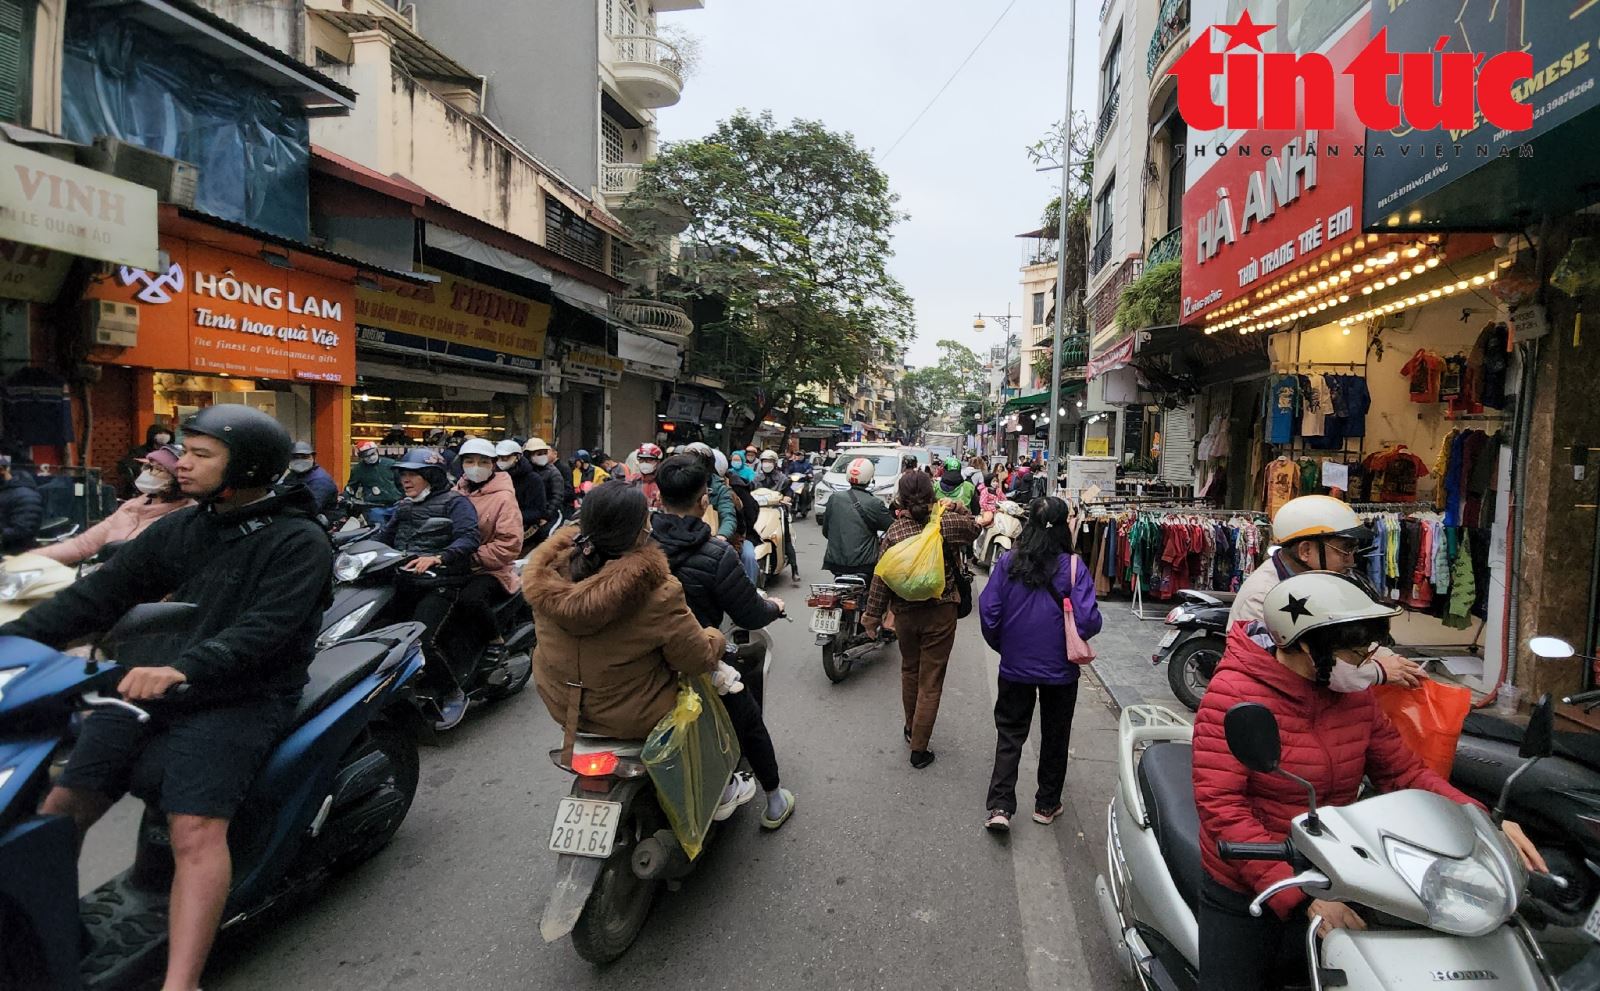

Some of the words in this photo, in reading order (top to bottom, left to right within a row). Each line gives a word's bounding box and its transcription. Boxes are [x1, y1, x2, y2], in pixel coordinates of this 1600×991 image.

[14, 164, 127, 226] VINH
[1196, 186, 1238, 265] HÀ
[1240, 130, 1319, 235] ANH
[1238, 257, 1259, 288] THỜI
[1260, 240, 1295, 277] TRANG
[1298, 217, 1323, 256] TRẺ
[288, 291, 342, 322] LAM
[451, 281, 531, 327] THỊNH
[1183, 296, 1192, 318] 12
[196, 307, 238, 331] Tinh
[241, 316, 275, 338] hoa
[277, 323, 309, 343] quà
[311, 327, 340, 351] Việt
[194, 336, 212, 348] The
[216, 340, 247, 353] finest
[250, 346, 261, 355] of
[265, 346, 316, 362] Vietnamese
[318, 355, 337, 364] gifts
[564, 803, 610, 828] 29-E2
[552, 826, 608, 853] 281.64
[1431, 970, 1499, 981] HONDA
